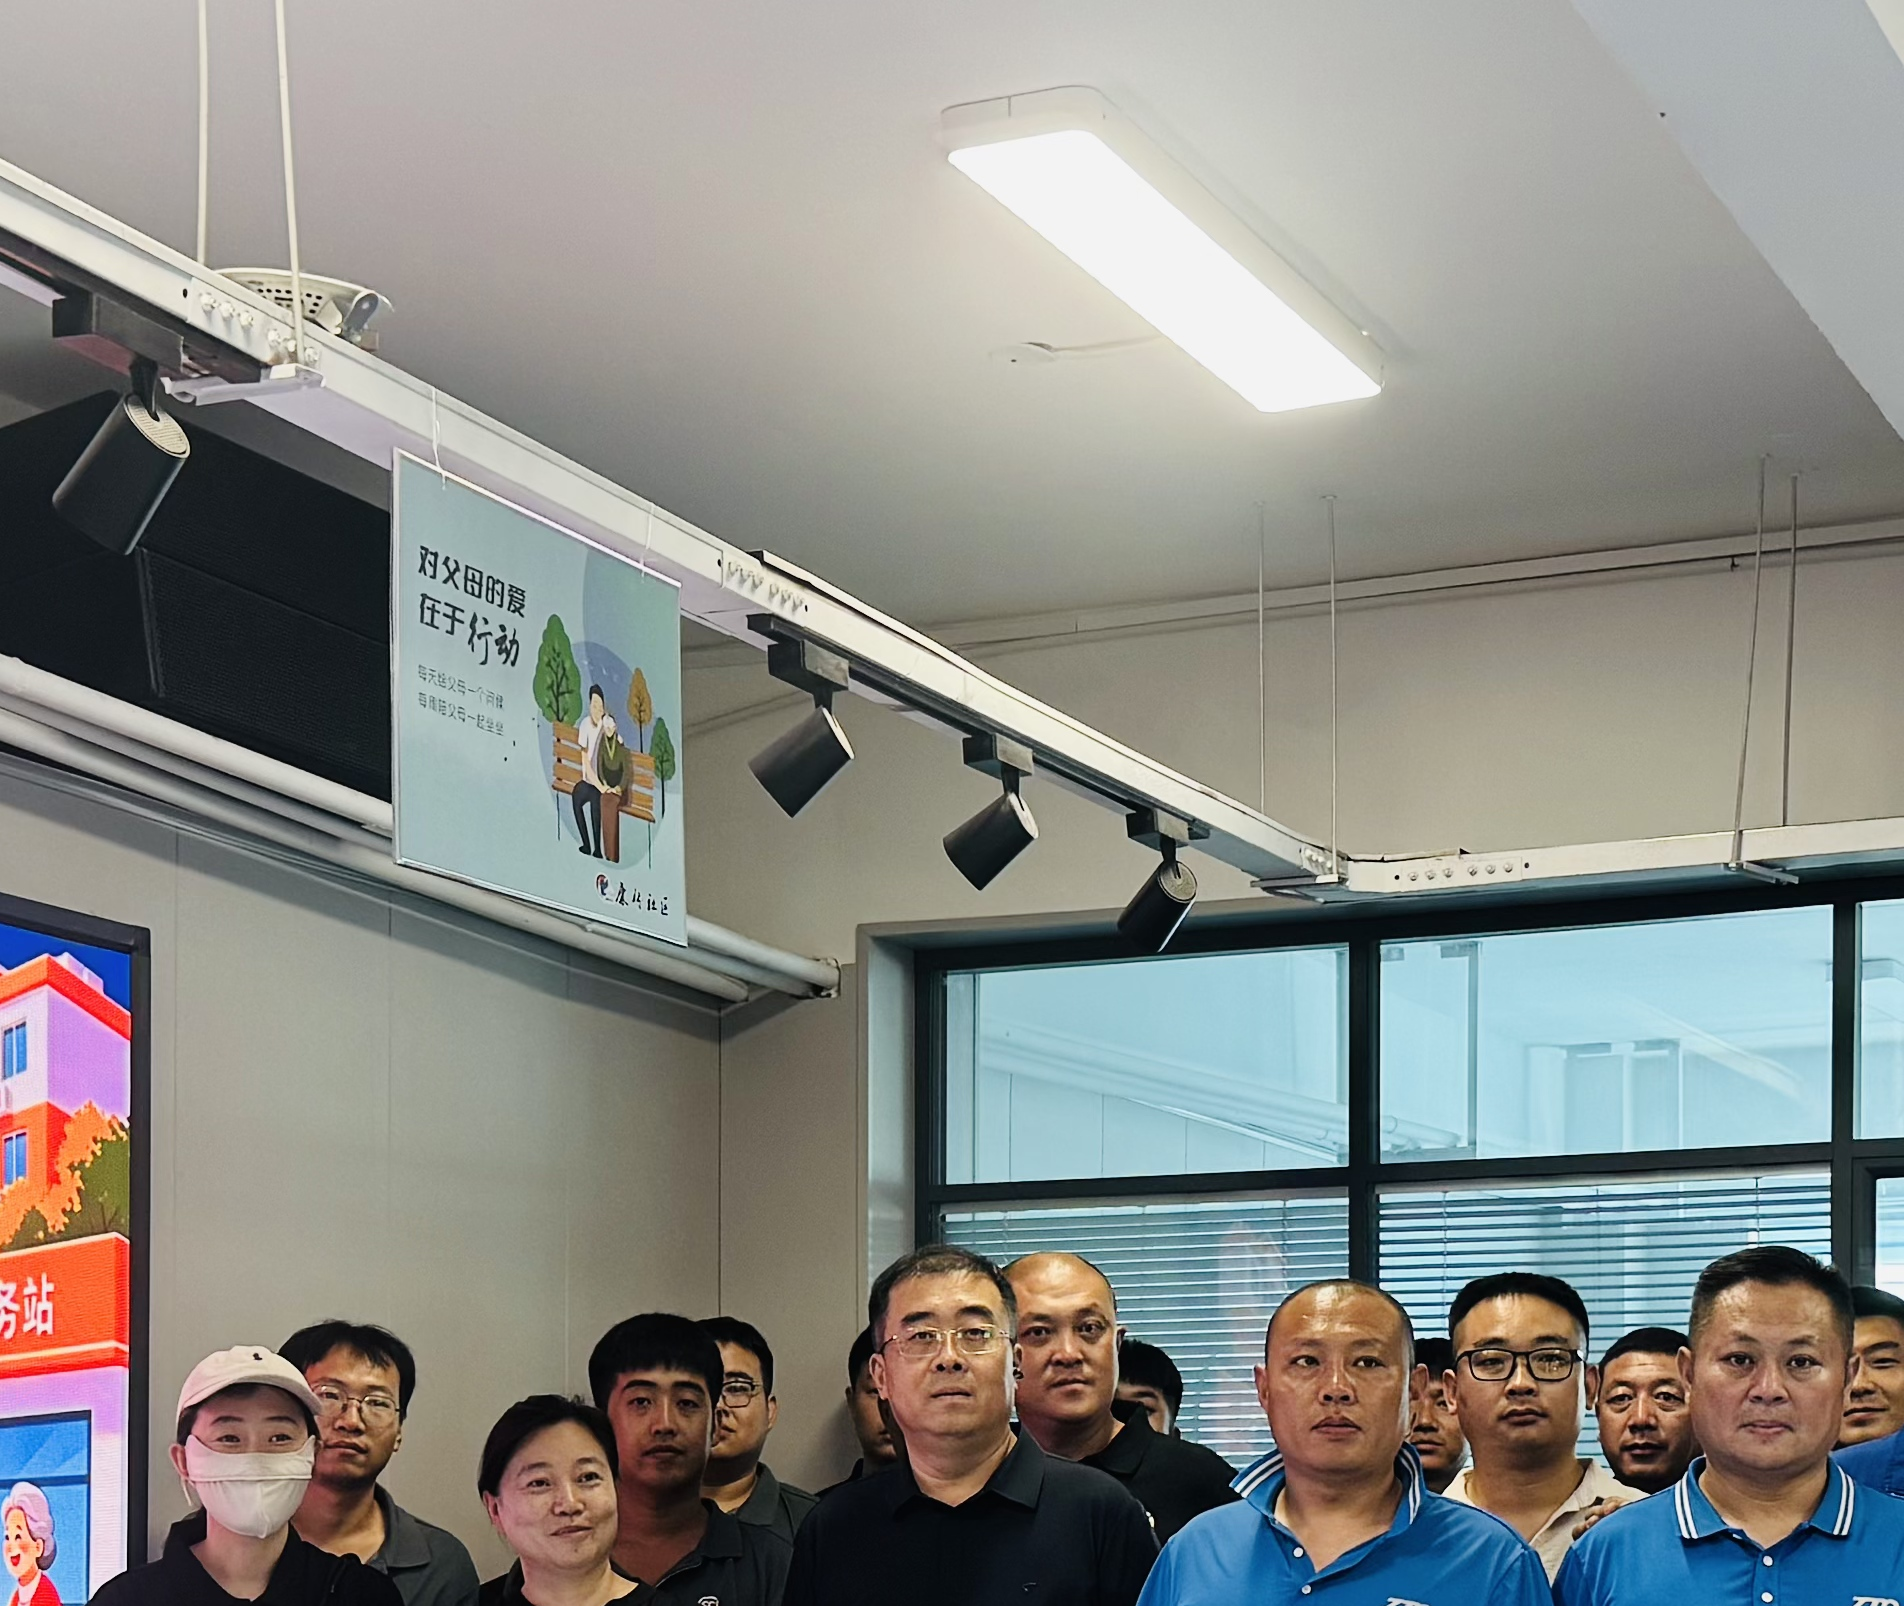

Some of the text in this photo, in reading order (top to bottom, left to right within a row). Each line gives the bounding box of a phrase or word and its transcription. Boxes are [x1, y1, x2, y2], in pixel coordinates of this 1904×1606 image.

[418, 545, 526, 618] 对父母的爱
[419, 592, 520, 667] 在于行动
